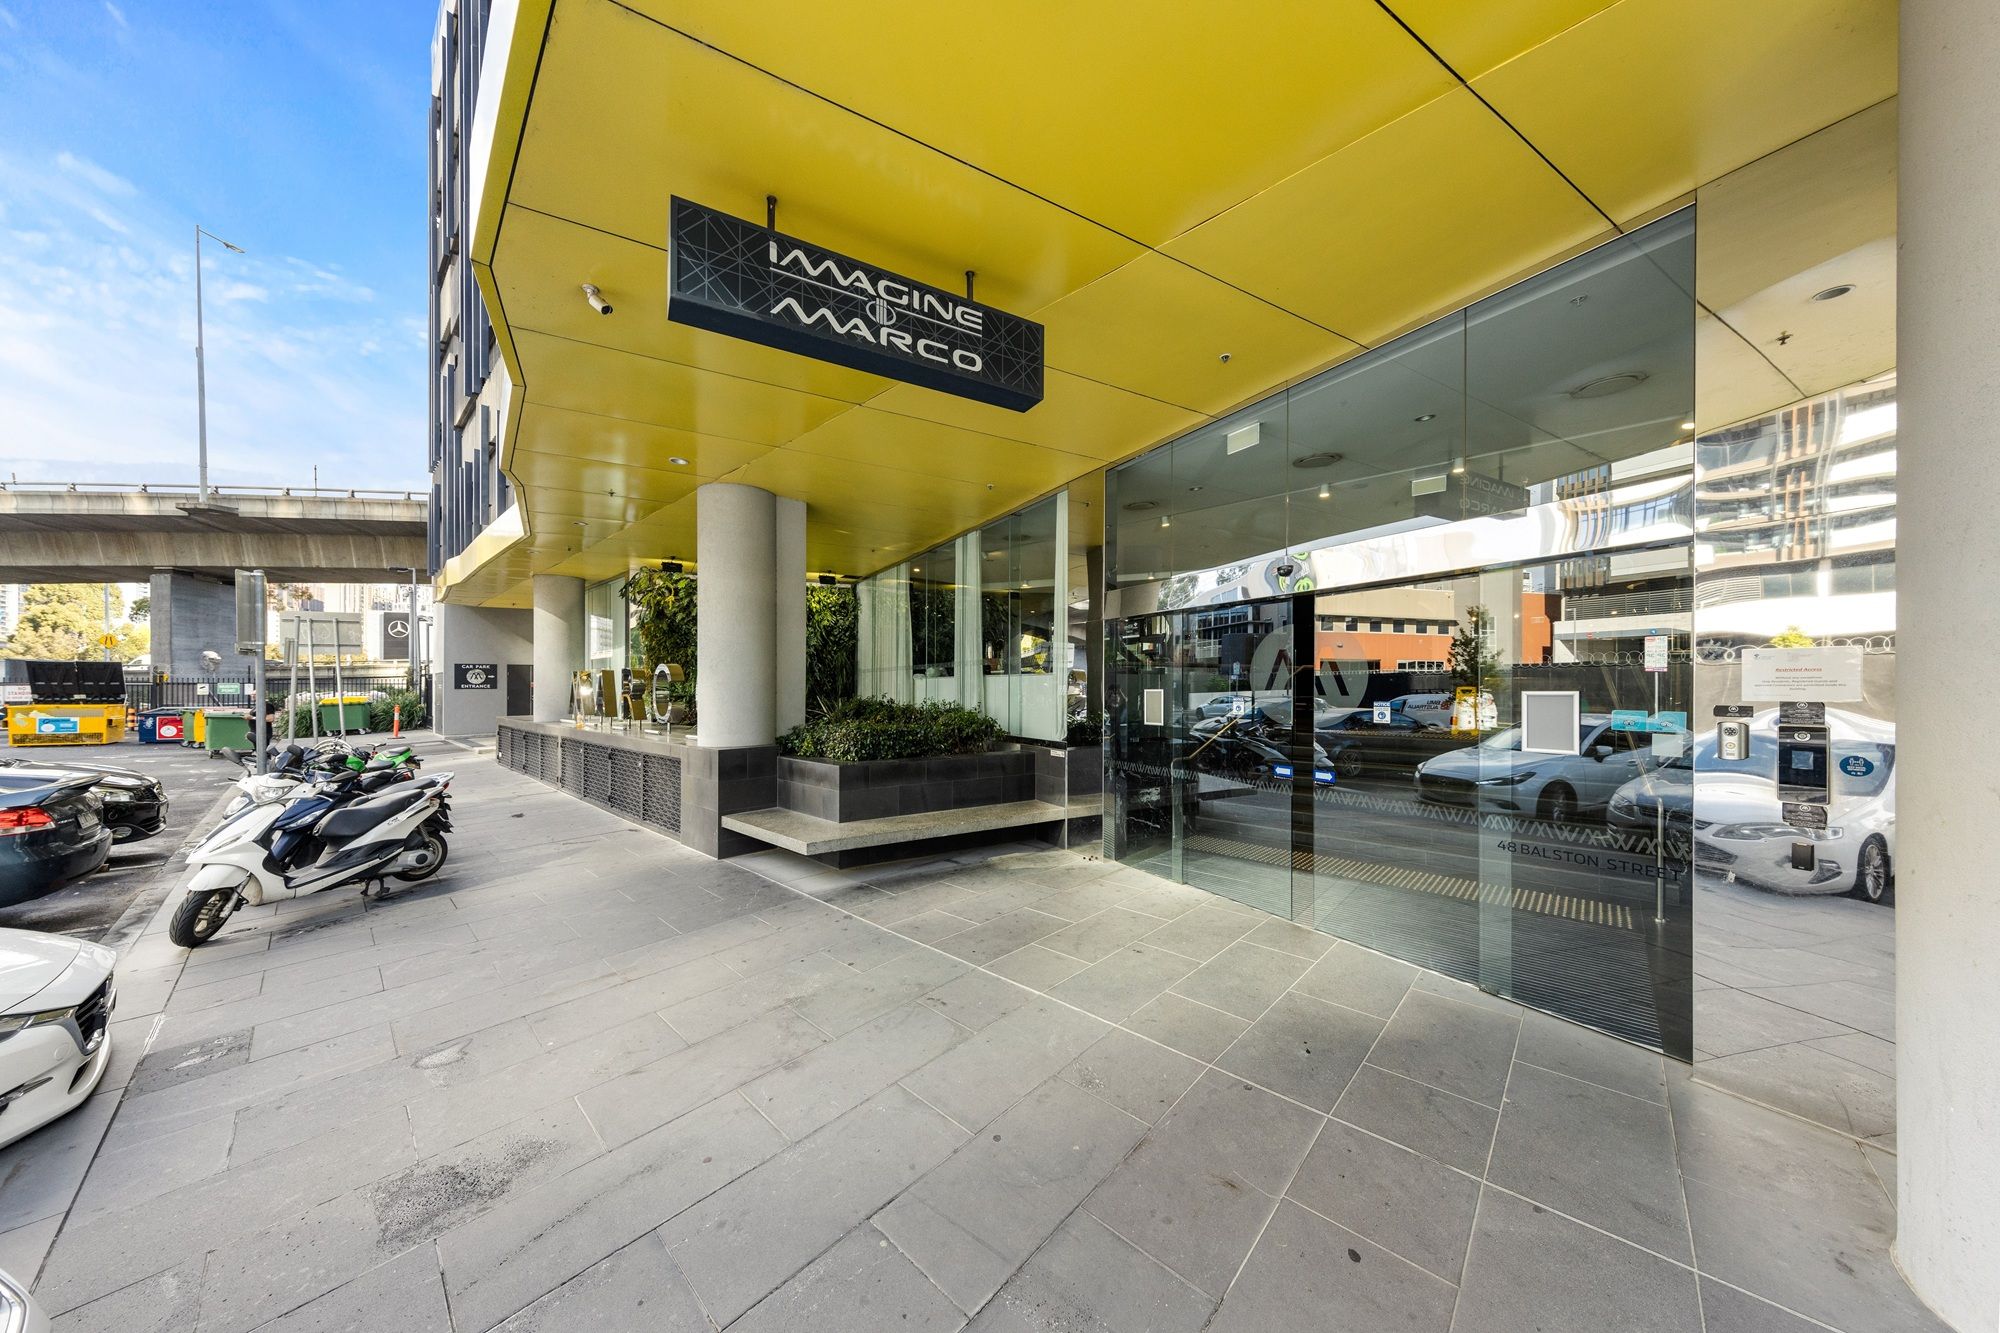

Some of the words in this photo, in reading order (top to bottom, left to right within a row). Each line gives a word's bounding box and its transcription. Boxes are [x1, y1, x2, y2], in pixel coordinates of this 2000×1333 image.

[769, 241, 983, 331] IMAGINE
[770, 297, 983, 372] MARCO
[1497, 839, 1517, 853] 48
[1520, 844, 1599, 868] BALSTON
[1607, 859, 1683, 881] STREET
